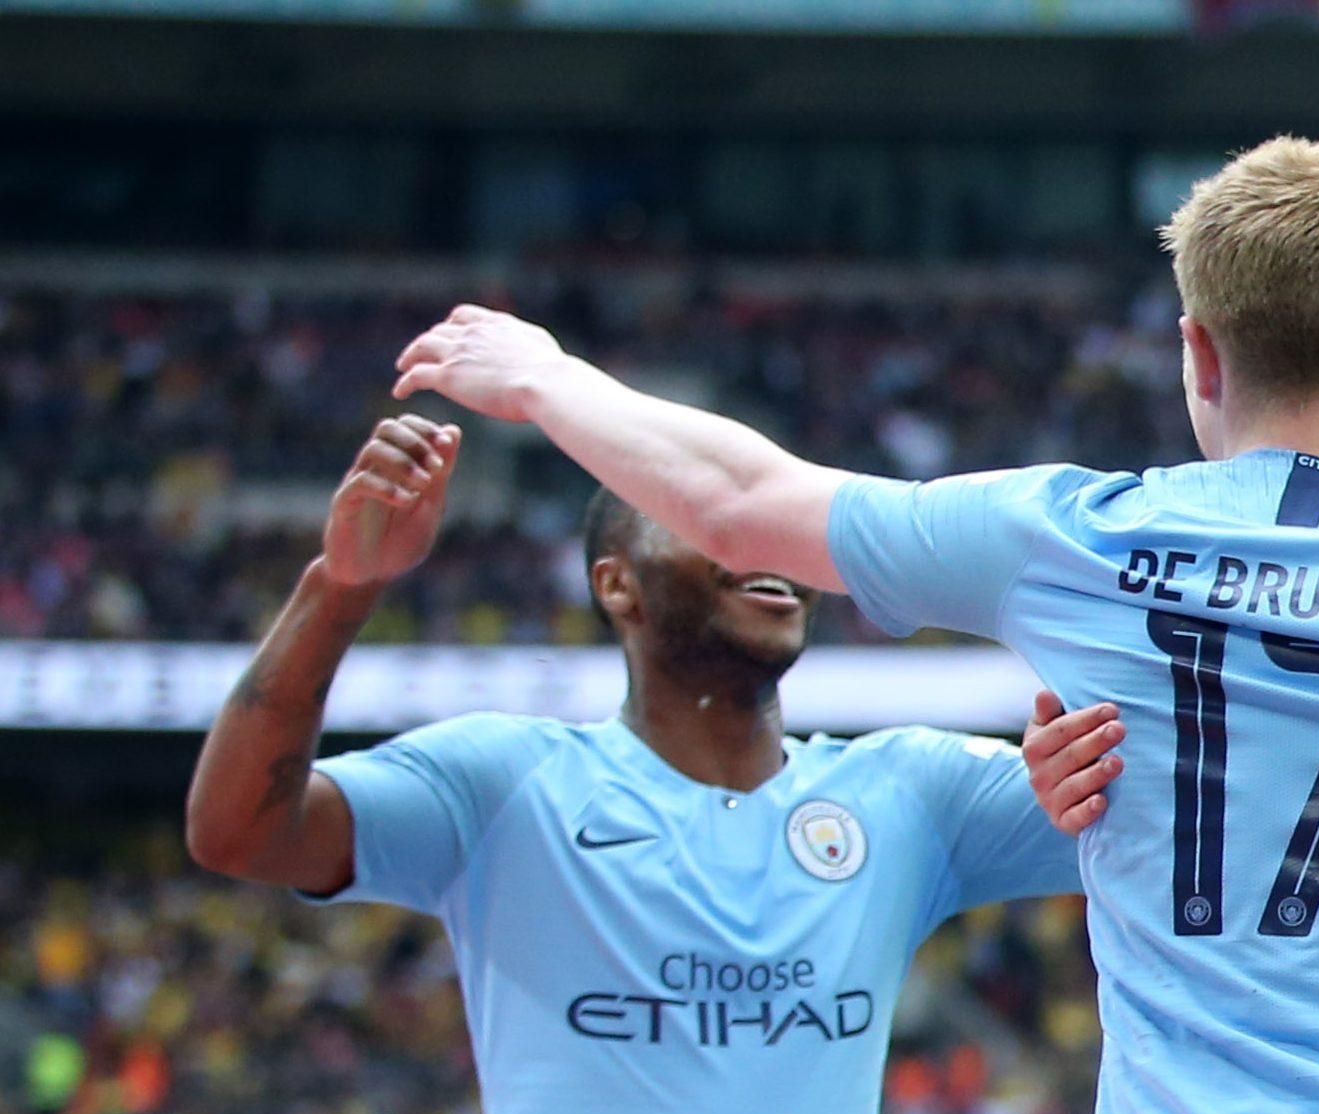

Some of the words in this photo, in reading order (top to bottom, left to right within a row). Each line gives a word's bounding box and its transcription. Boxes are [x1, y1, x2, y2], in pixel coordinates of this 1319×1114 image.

[1118, 548, 1197, 602] DE
[659, 952, 816, 993] Choose
[566, 989, 874, 1047] ETIHAD
